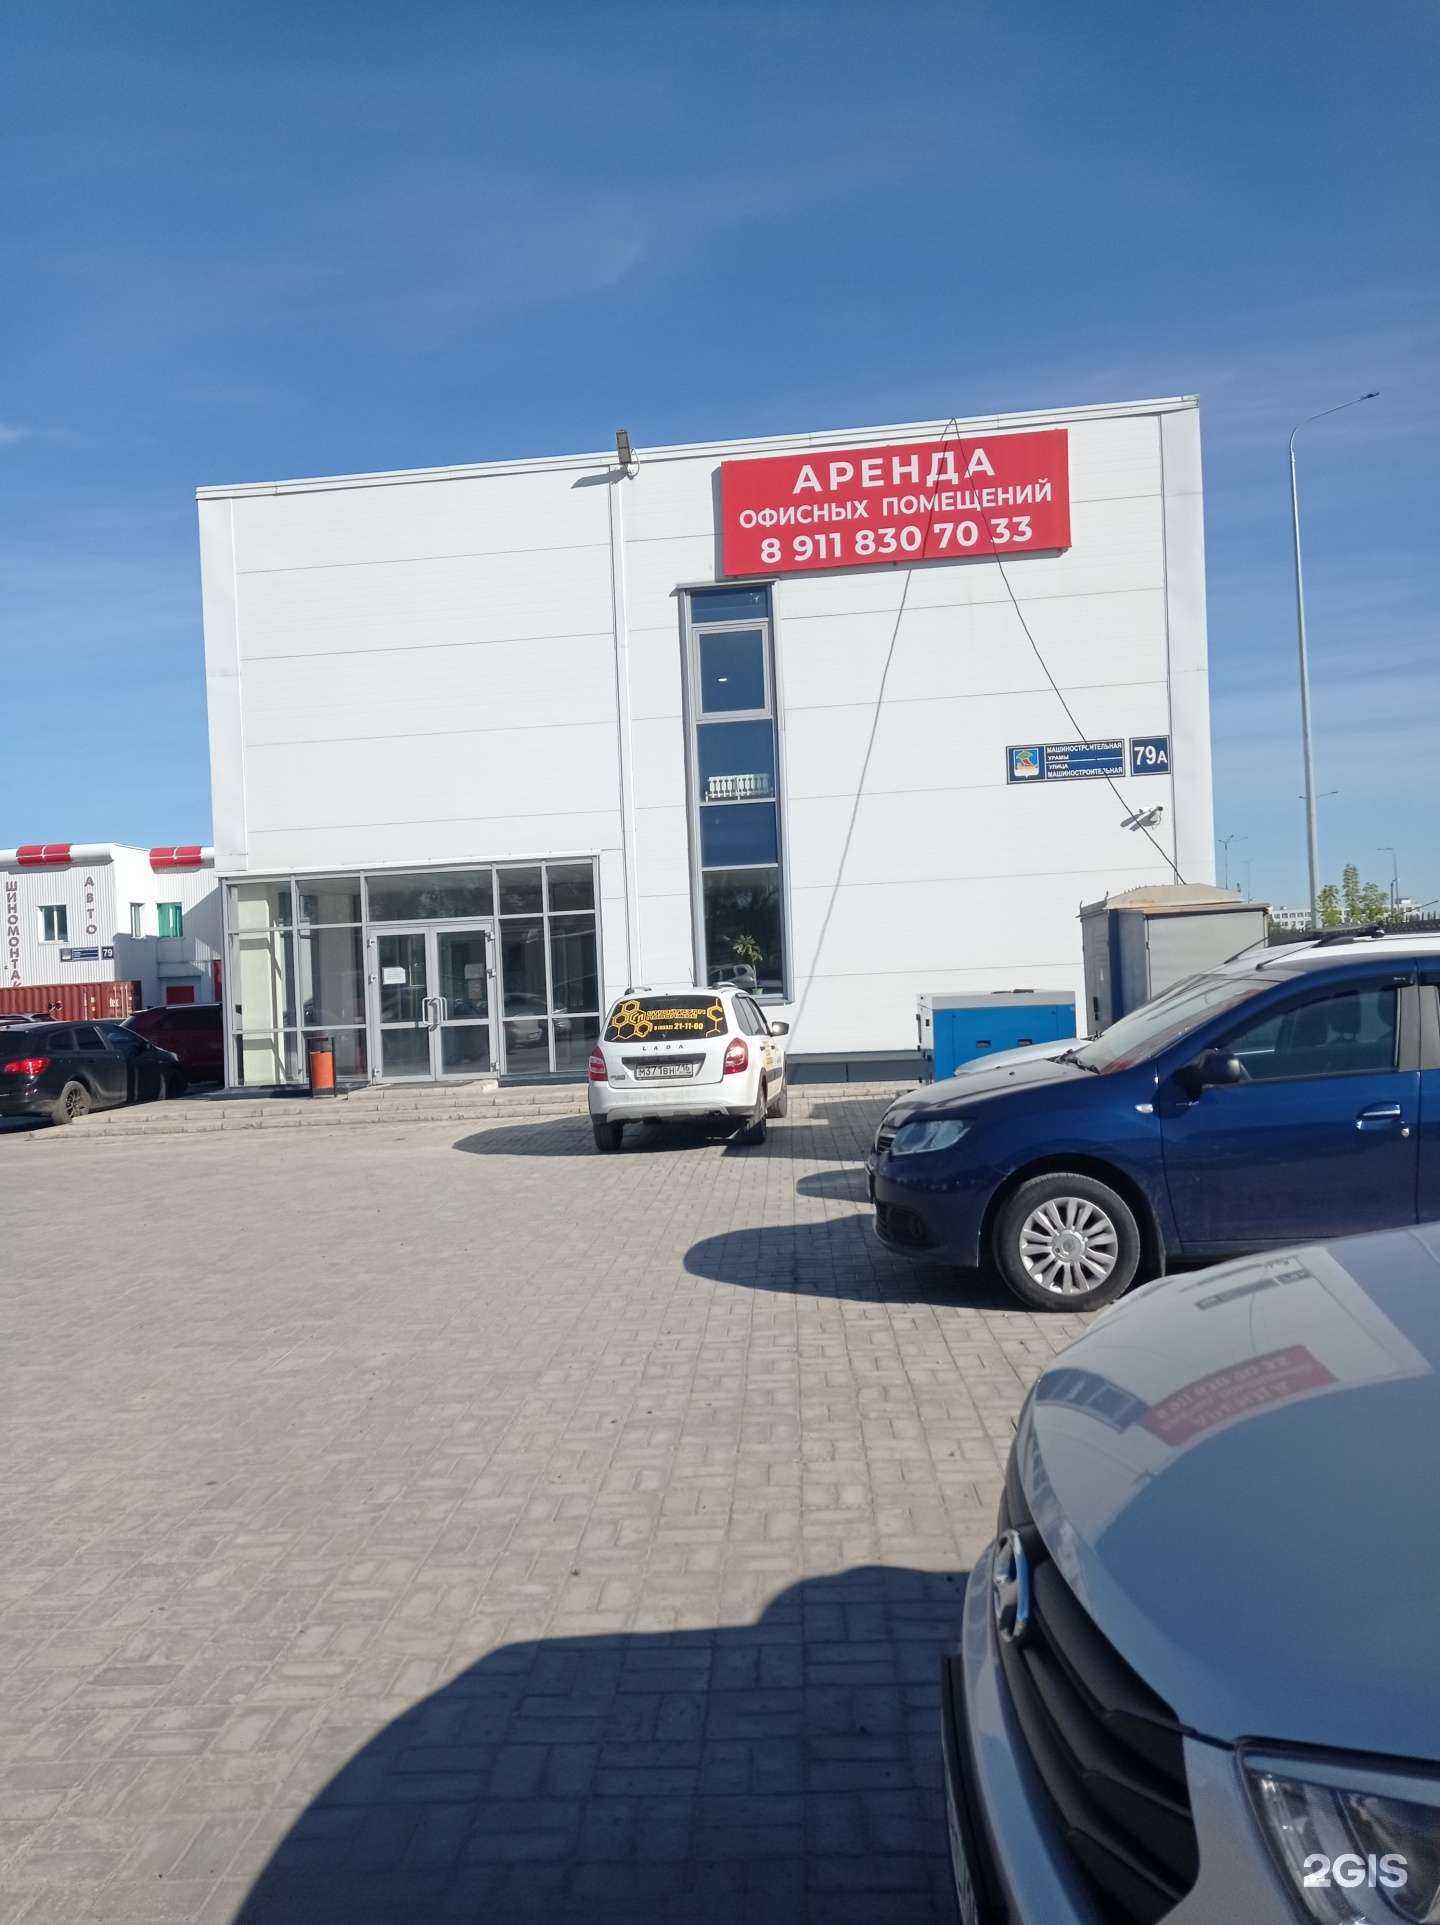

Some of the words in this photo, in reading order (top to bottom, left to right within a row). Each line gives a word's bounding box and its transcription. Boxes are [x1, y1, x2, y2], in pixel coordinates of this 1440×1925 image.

[792, 448, 995, 494] АРЕНДА
[739, 499, 869, 529] ОФИСНЫХ
[882, 478, 1052, 517] ПОМЕЩЕНИЙ
[760, 537, 782, 563] 8
[793, 532, 841, 561] 911
[854, 525, 922, 556] 830
[933, 521, 978, 549] 70
[990, 516, 1033, 544] 33
[1047, 767, 1123, 778] МАШИНОСТРОИТЕЛЬНАЯ
[1134, 745, 1168, 766] 79А
[84, 876, 97, 934] АВТО
[102, 949, 113, 957] 79
